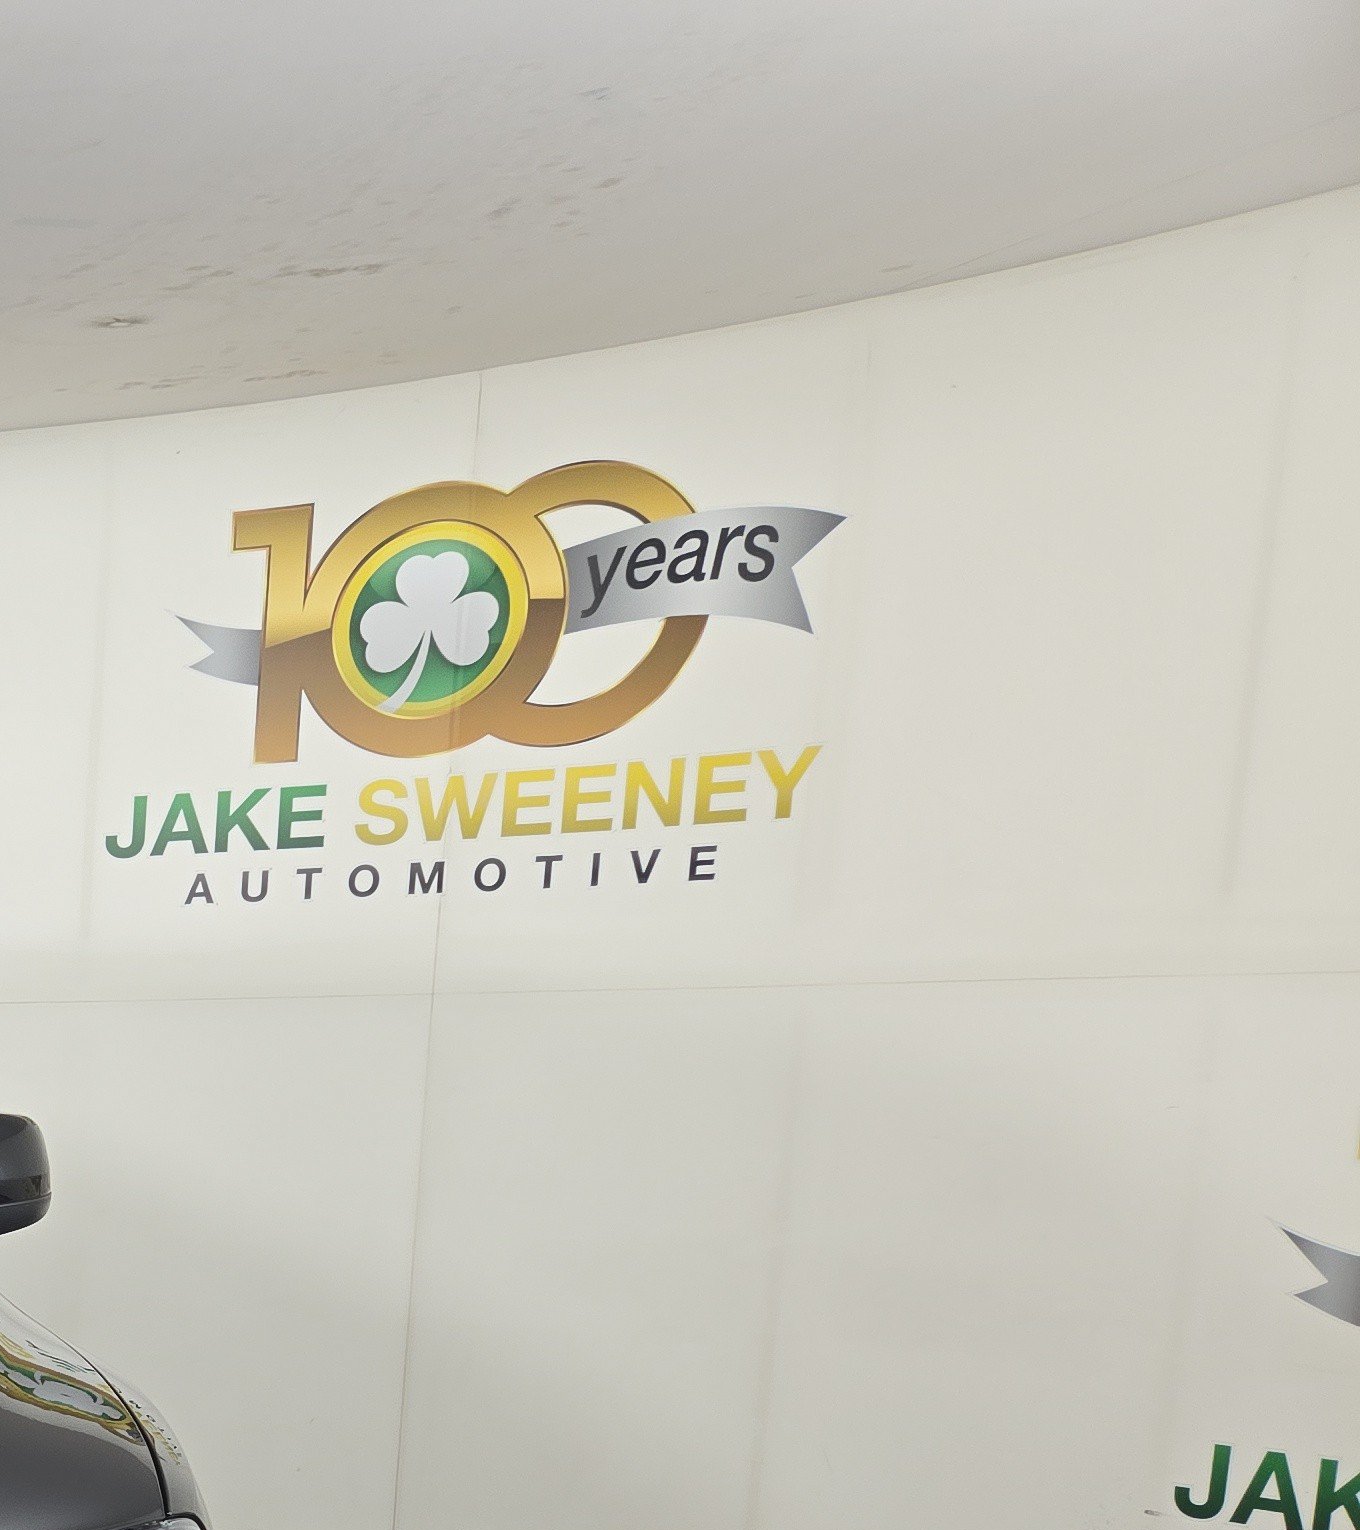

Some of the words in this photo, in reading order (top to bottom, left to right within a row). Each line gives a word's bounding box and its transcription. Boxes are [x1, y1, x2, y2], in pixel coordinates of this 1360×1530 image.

[232, 460, 709, 765] 100
[579, 522, 780, 619] years
[104, 783, 328, 860] JAKE
[354, 744, 822, 847] SWEENEY
[183, 845, 719, 906] AUTOMOTIVE
